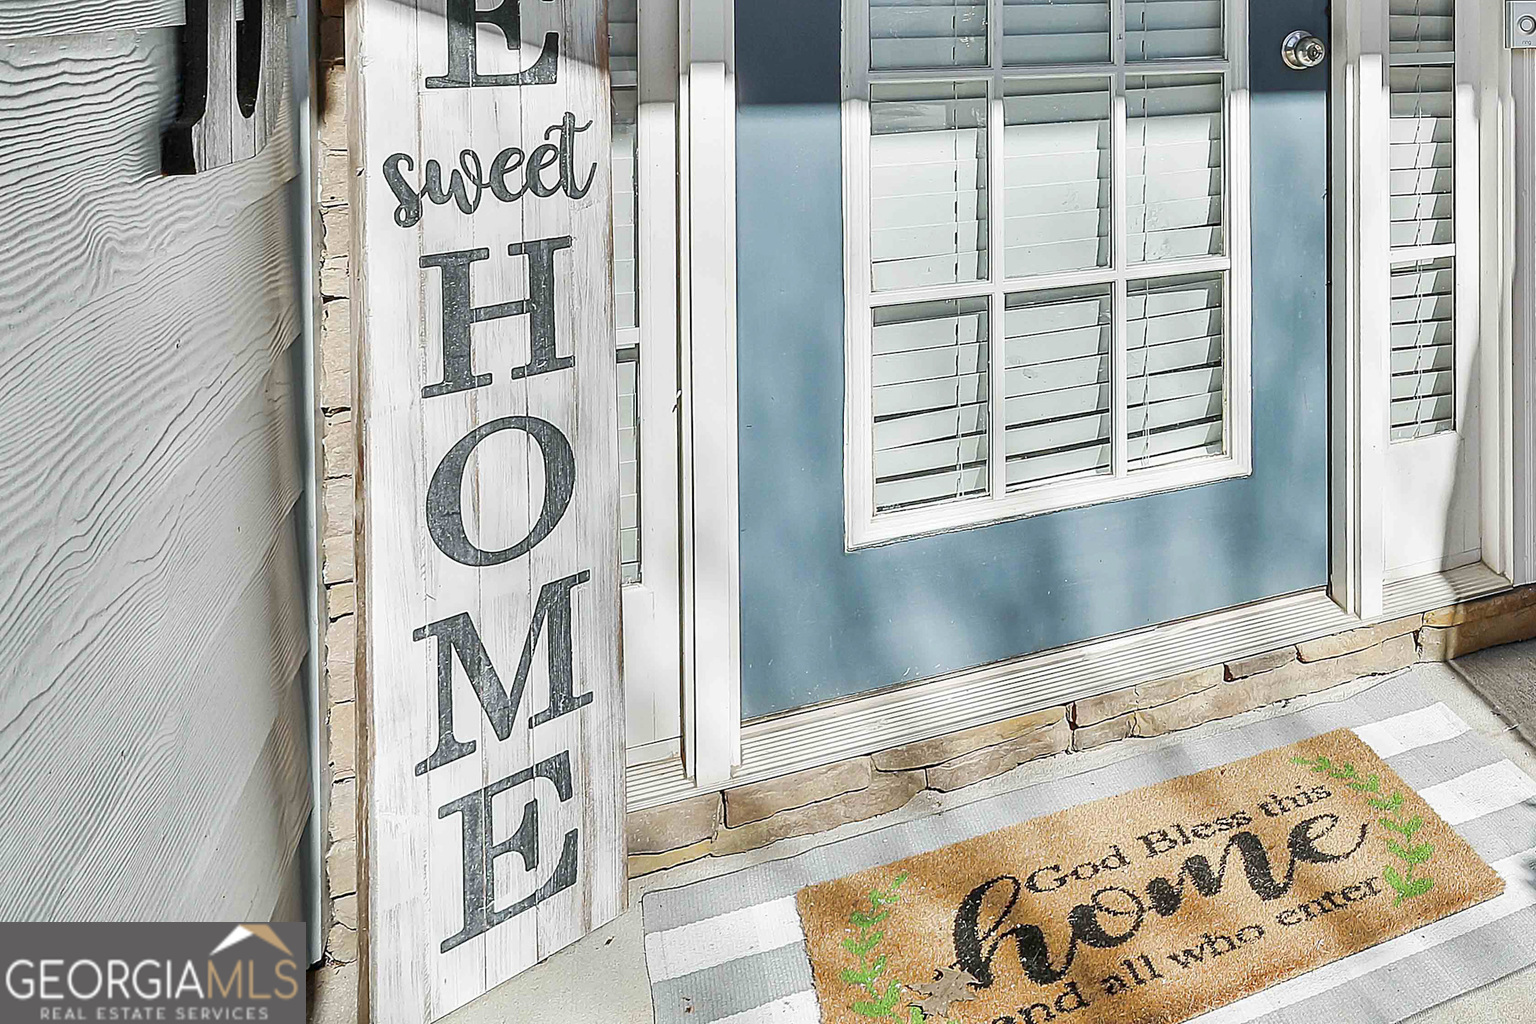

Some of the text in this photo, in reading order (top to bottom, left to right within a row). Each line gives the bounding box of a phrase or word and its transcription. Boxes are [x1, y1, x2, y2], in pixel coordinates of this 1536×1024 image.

[383, 111, 598, 228] sweet
[413, 234, 595, 955] HOME
[1025, 784, 1332, 894] God Bless this
[953, 813, 1369, 990] home
[1102, 954, 1163, 996] all
[1167, 924, 1265, 970] who
[1275, 875, 1383, 929] enter
